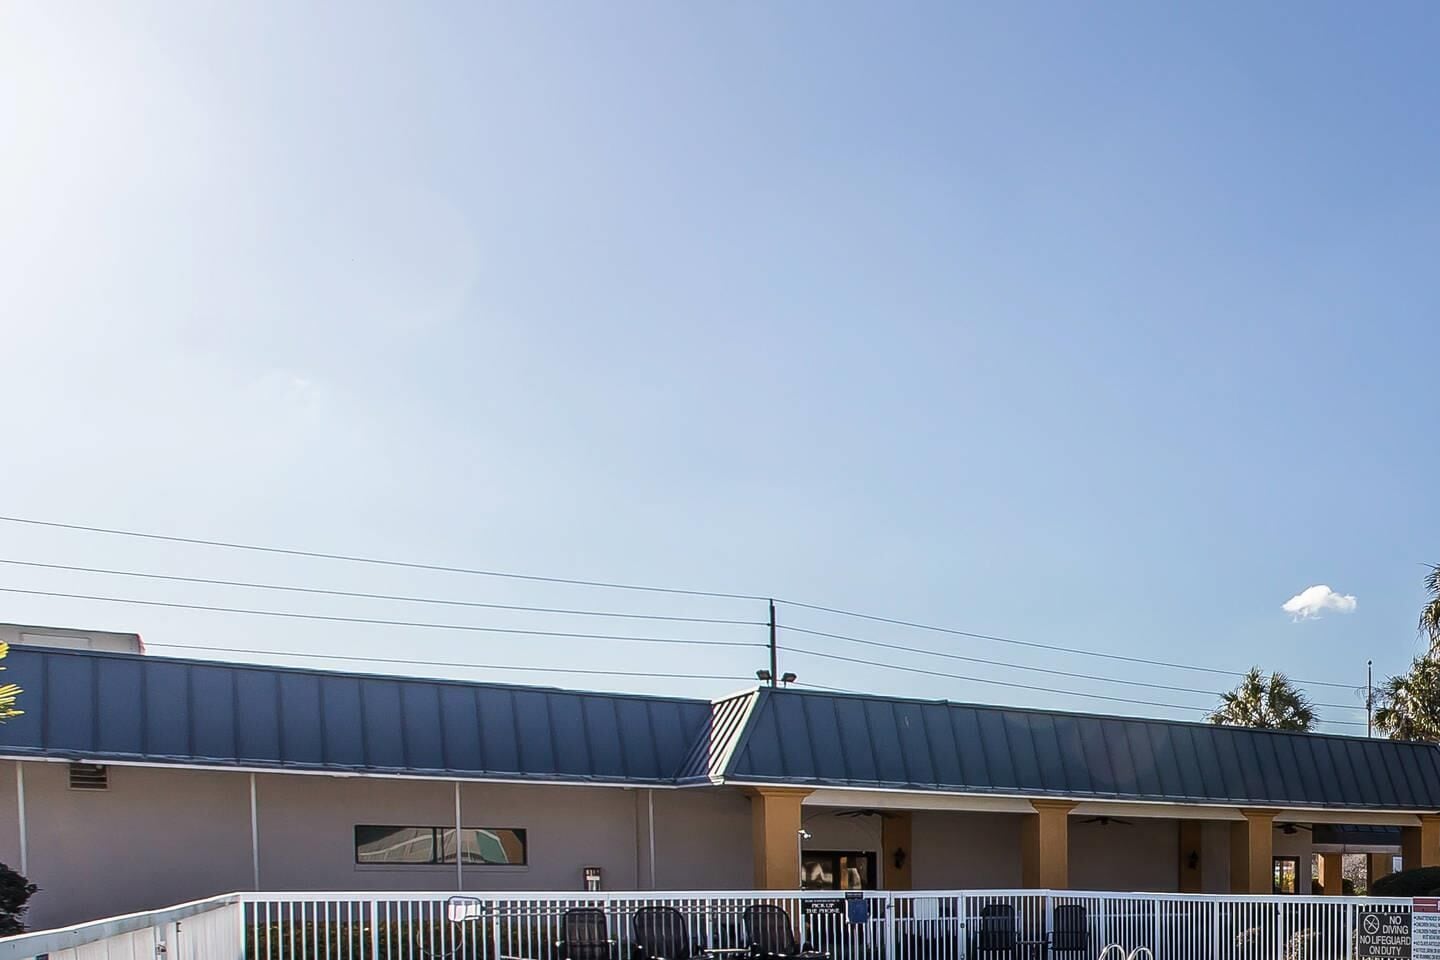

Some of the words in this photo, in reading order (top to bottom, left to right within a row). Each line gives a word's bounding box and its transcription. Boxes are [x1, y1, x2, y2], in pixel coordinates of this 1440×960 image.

[1389, 916, 1402, 925] NO
[1382, 925, 1409, 935] DIVING
[1360, 935, 1370, 944] NO
[1372, 936, 1411, 946] LIFEGUARD
[1369, 946, 1380, 954] ON
[1381, 946, 1402, 955] DUTY
